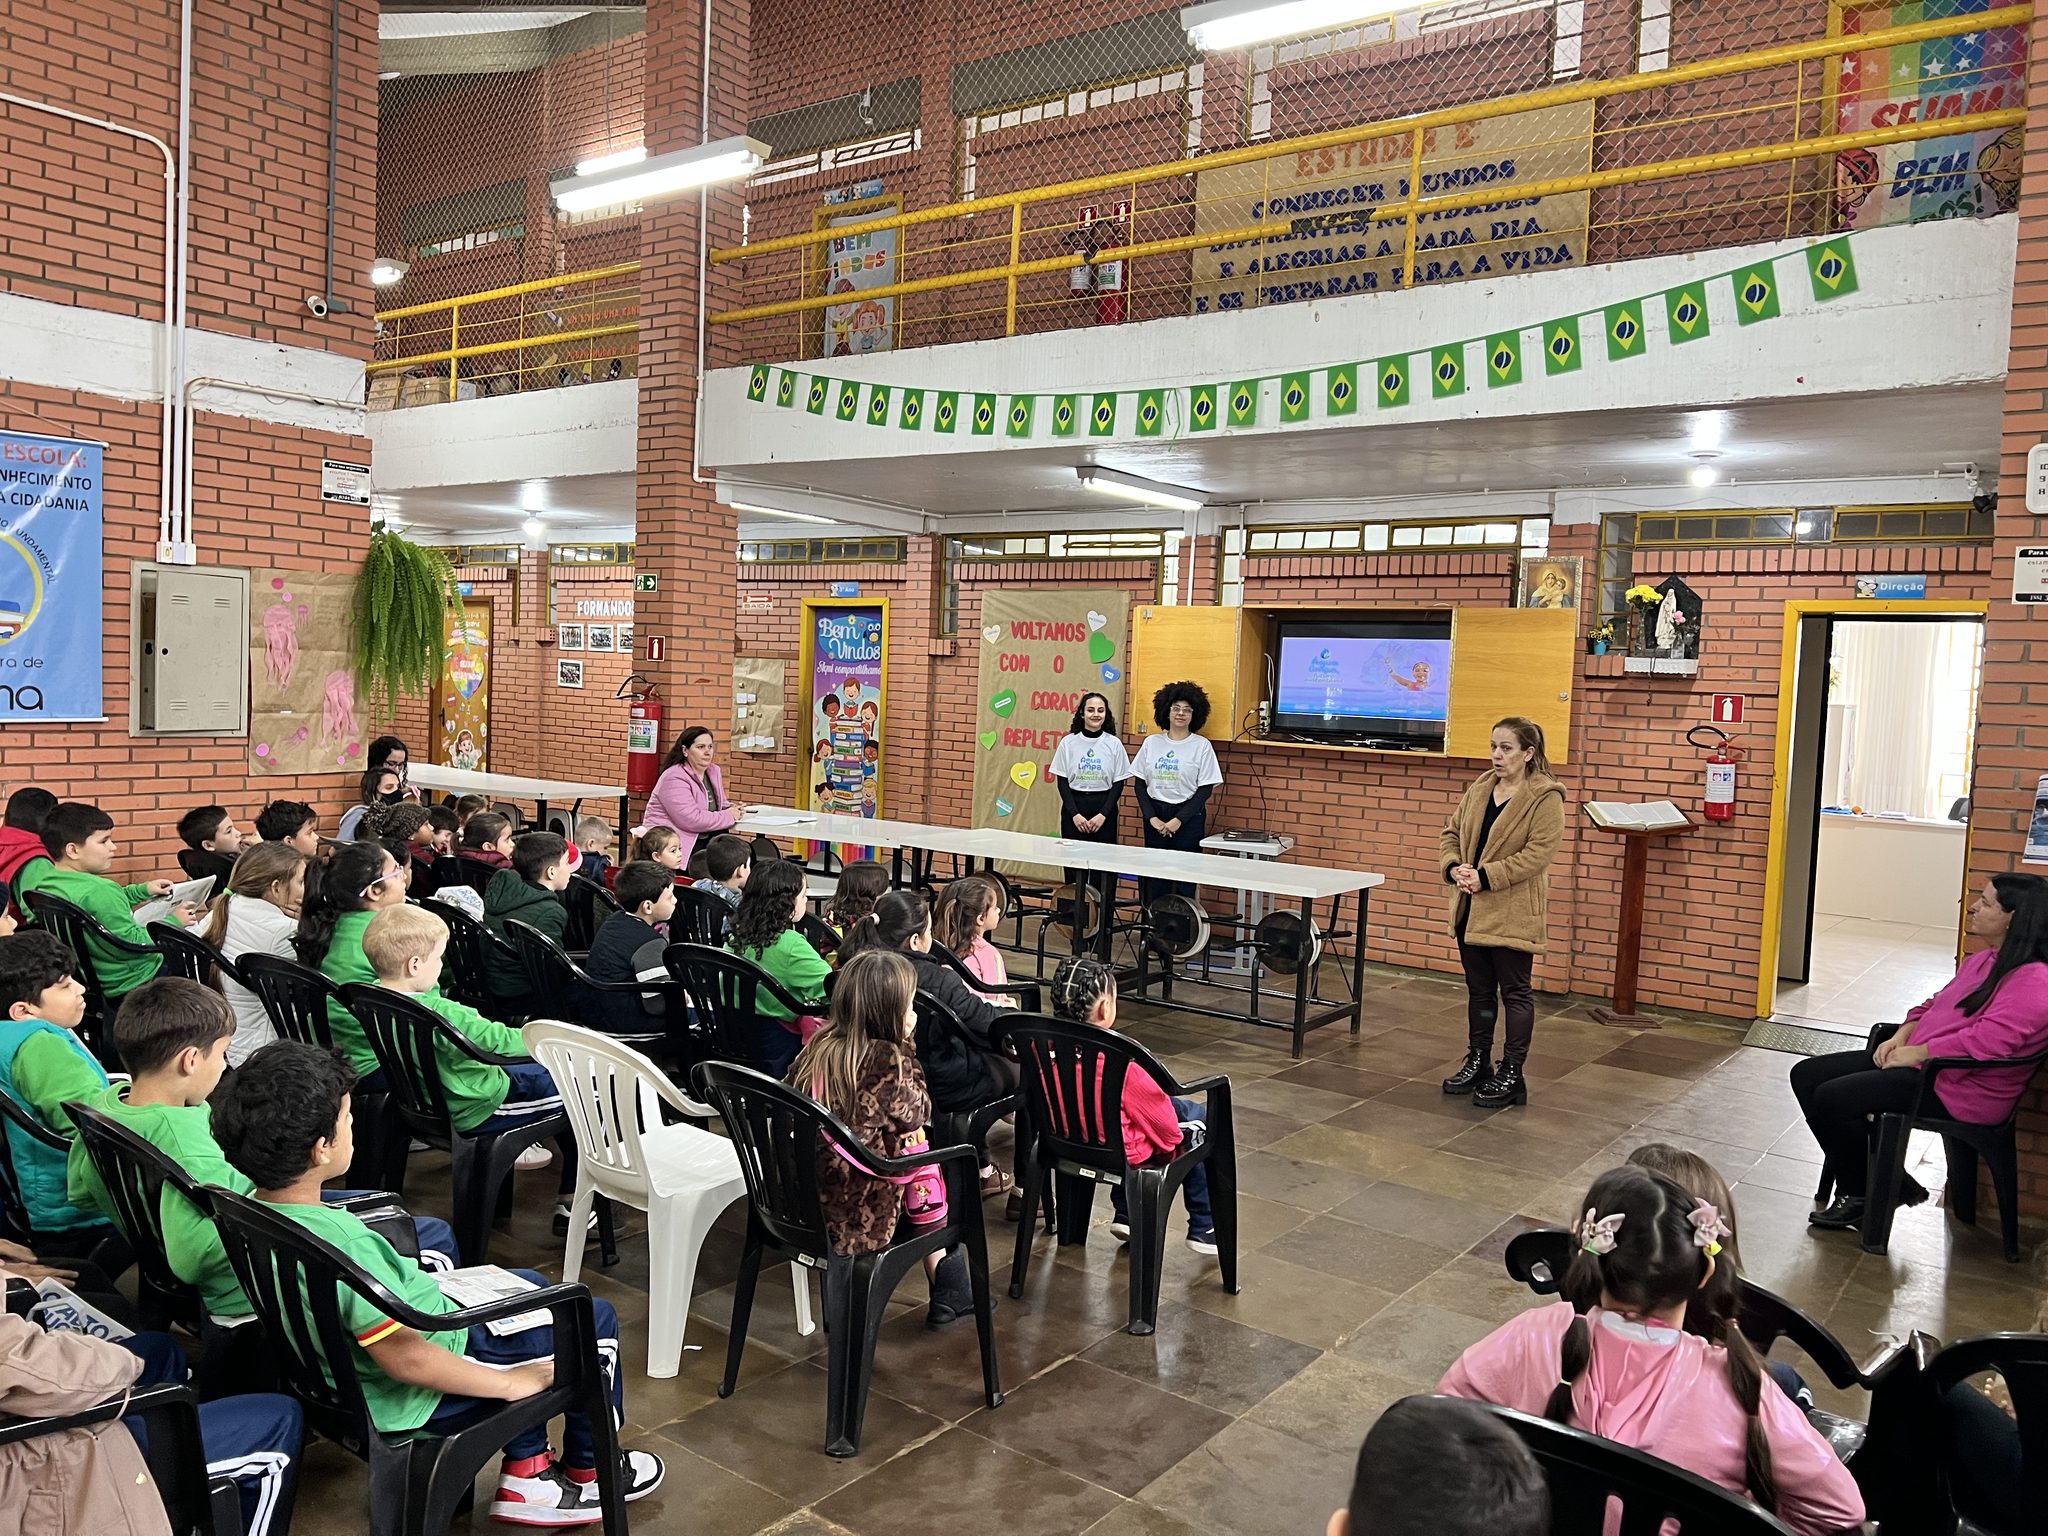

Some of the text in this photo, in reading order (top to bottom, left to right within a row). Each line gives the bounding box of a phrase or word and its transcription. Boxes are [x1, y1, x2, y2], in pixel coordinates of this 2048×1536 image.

[1889, 151, 1970, 199] BEM
[1252, 183, 1385, 219] CONHECER
[833, 232, 873, 254] BEM
[1246, 244, 1367, 276] ALEGRIAS
[1375, 239, 1393, 258] A
[1255, 272, 1378, 304] PREPARAR
[1471, 254, 1492, 274] A
[1501, 243, 1573, 270] VIDA
[4, 442, 88, 468] ESCOLA:
[10, 492, 90, 512] CIDADANIA
[13, 527, 56, 585] UNDAMENTAL
[1880, 582, 1924, 593] Direção
[577, 600, 636, 618] FORMANDO
[818, 617, 861, 640] Bem
[1010, 620, 1086, 643] VOLTAMOS
[829, 637, 881, 661] Vindos
[23, 656, 44, 668] de
[999, 653, 1065, 674] COM O
[1031, 688, 1088, 714] CORAÇ
[1004, 727, 1068, 751] REPLET
